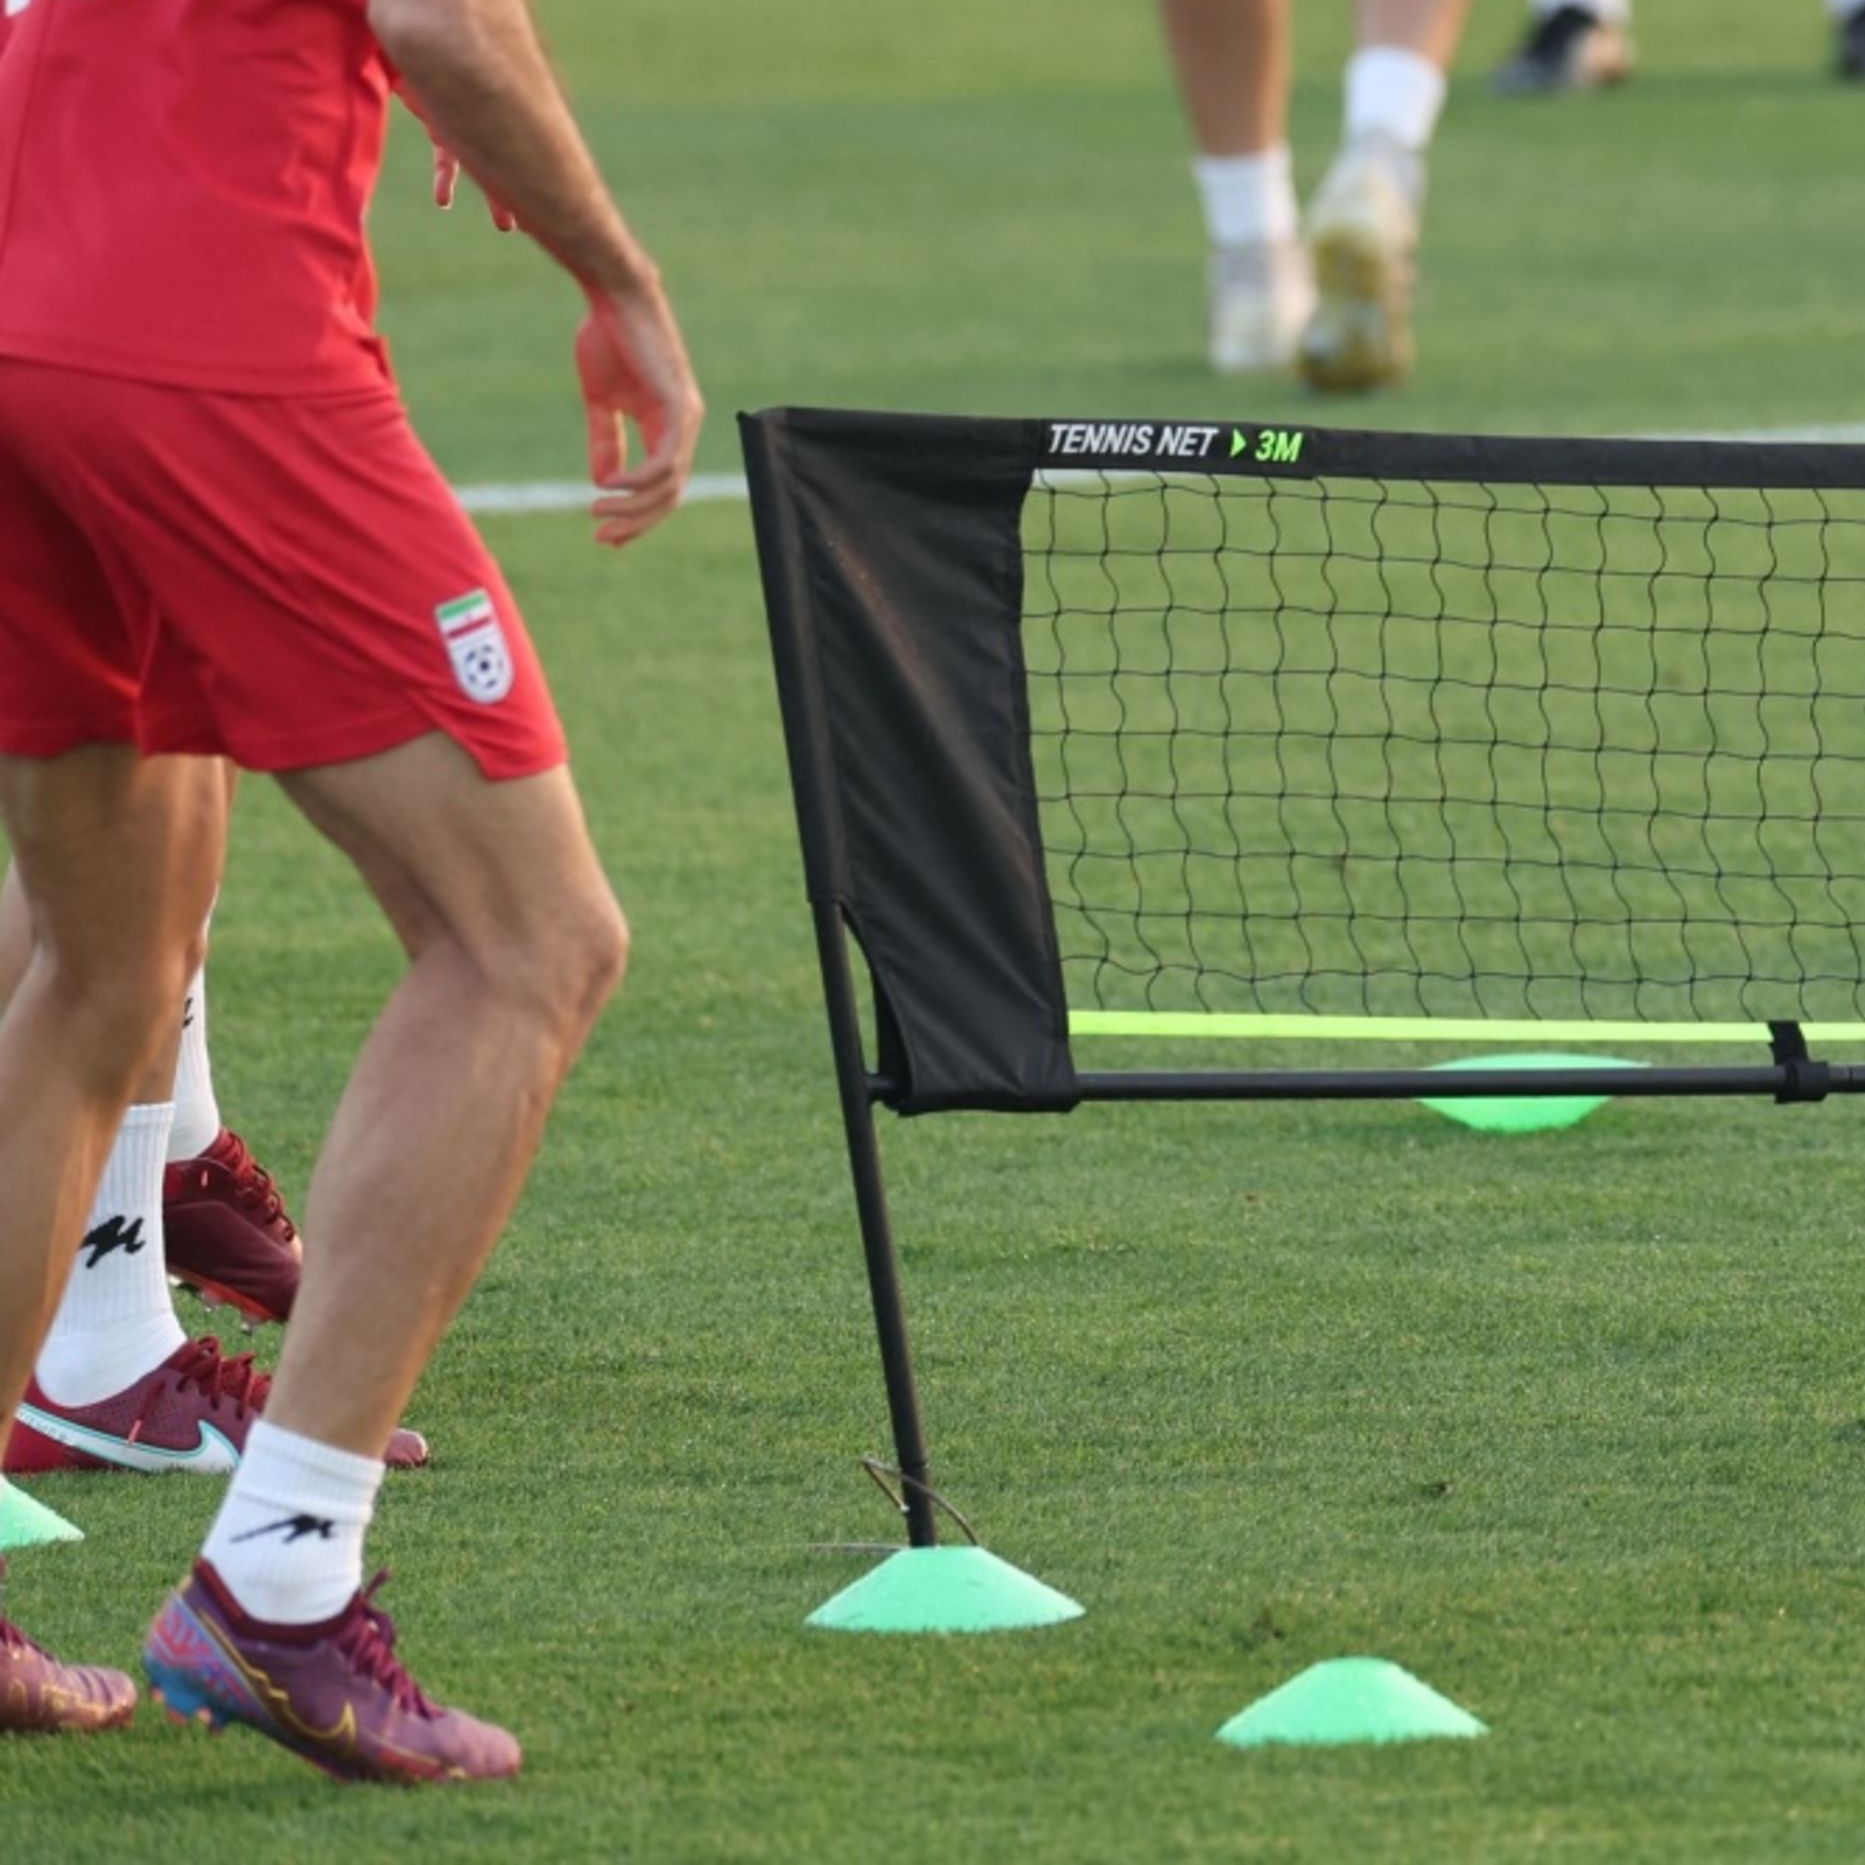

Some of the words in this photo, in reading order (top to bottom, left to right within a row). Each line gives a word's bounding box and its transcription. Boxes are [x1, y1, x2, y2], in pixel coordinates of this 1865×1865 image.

[1049, 423, 1153, 454] TENNIS
[1155, 426, 1218, 456] NET
[1254, 430, 1304, 463] 3M
